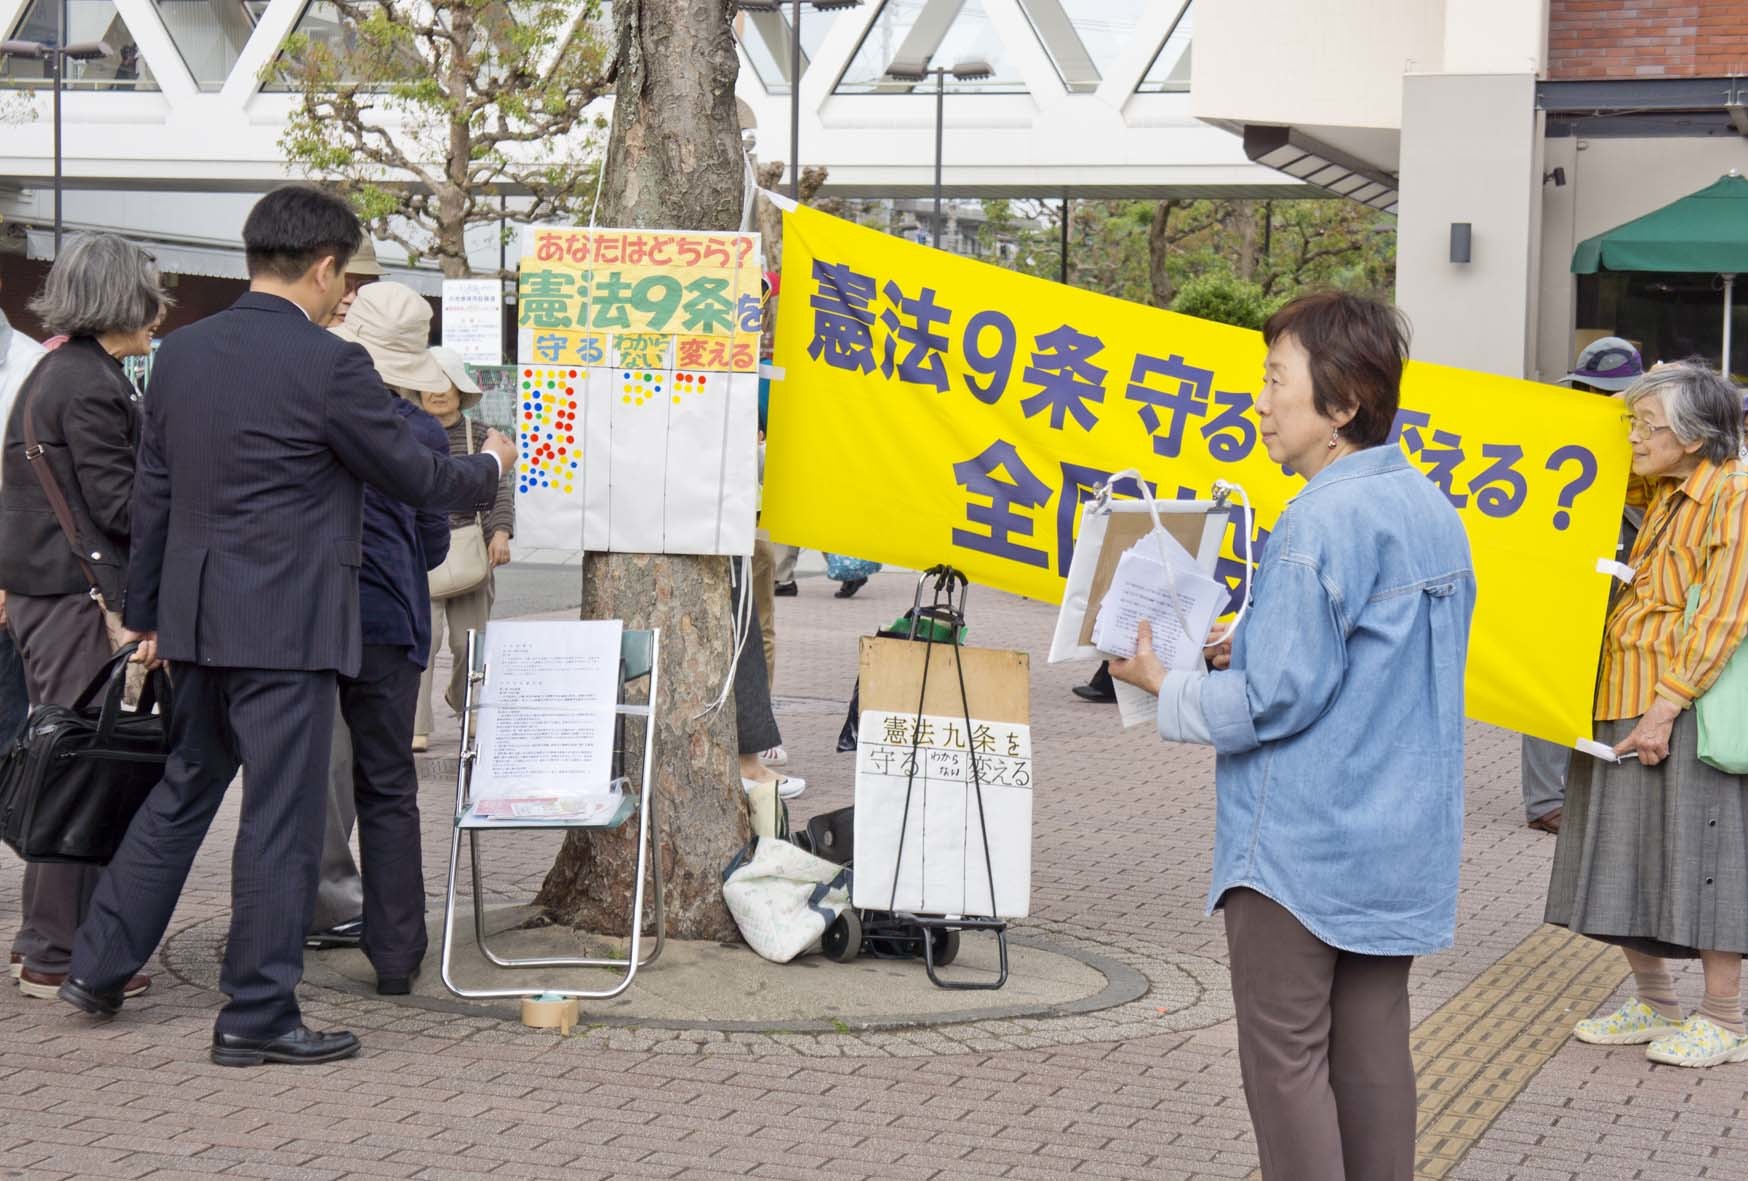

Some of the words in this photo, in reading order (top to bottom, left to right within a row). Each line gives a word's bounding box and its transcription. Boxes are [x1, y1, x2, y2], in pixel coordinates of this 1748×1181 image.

[536, 232, 753, 268] あなたはどちら?
[518, 269, 763, 334] 憲法9条を
[536, 333, 604, 363] 守る
[620, 350, 663, 368] ない
[679, 338, 754, 369] 変える
[808, 257, 1107, 433] 憲法9条
[1125, 353, 1296, 477] 守る
[883, 715, 1020, 757] 憲法九条を
[870, 747, 920, 777] 守る
[930, 751, 959, 765] わから
[939, 765, 960, 777] ない
[967, 755, 1030, 786] 変える
